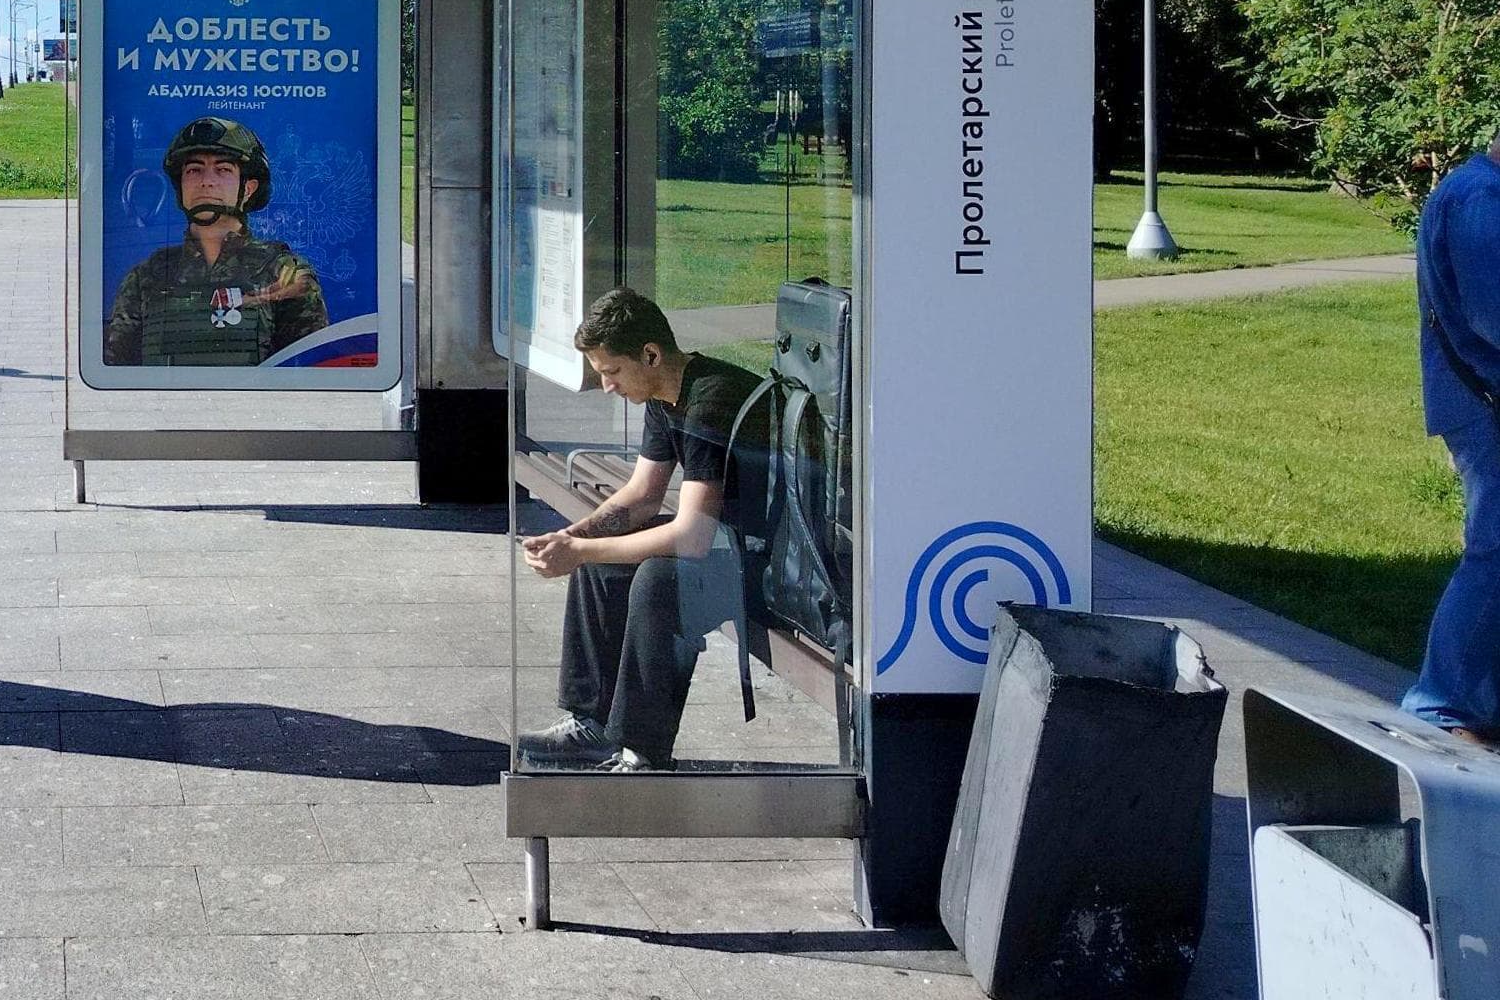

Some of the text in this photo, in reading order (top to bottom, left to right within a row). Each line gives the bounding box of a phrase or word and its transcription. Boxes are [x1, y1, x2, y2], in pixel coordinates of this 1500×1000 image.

[147, 17, 331, 43] ДОБЛЕСТЬ
[117, 47, 360, 73] И МУЖЕСТВО!
[147, 84, 327, 98] АБДУЛАЗИЗ ЮСУПОВ
[207, 101, 266, 110] ЛЕЙТЕНАНТ
[954, 11, 991, 275] Пролетарский
